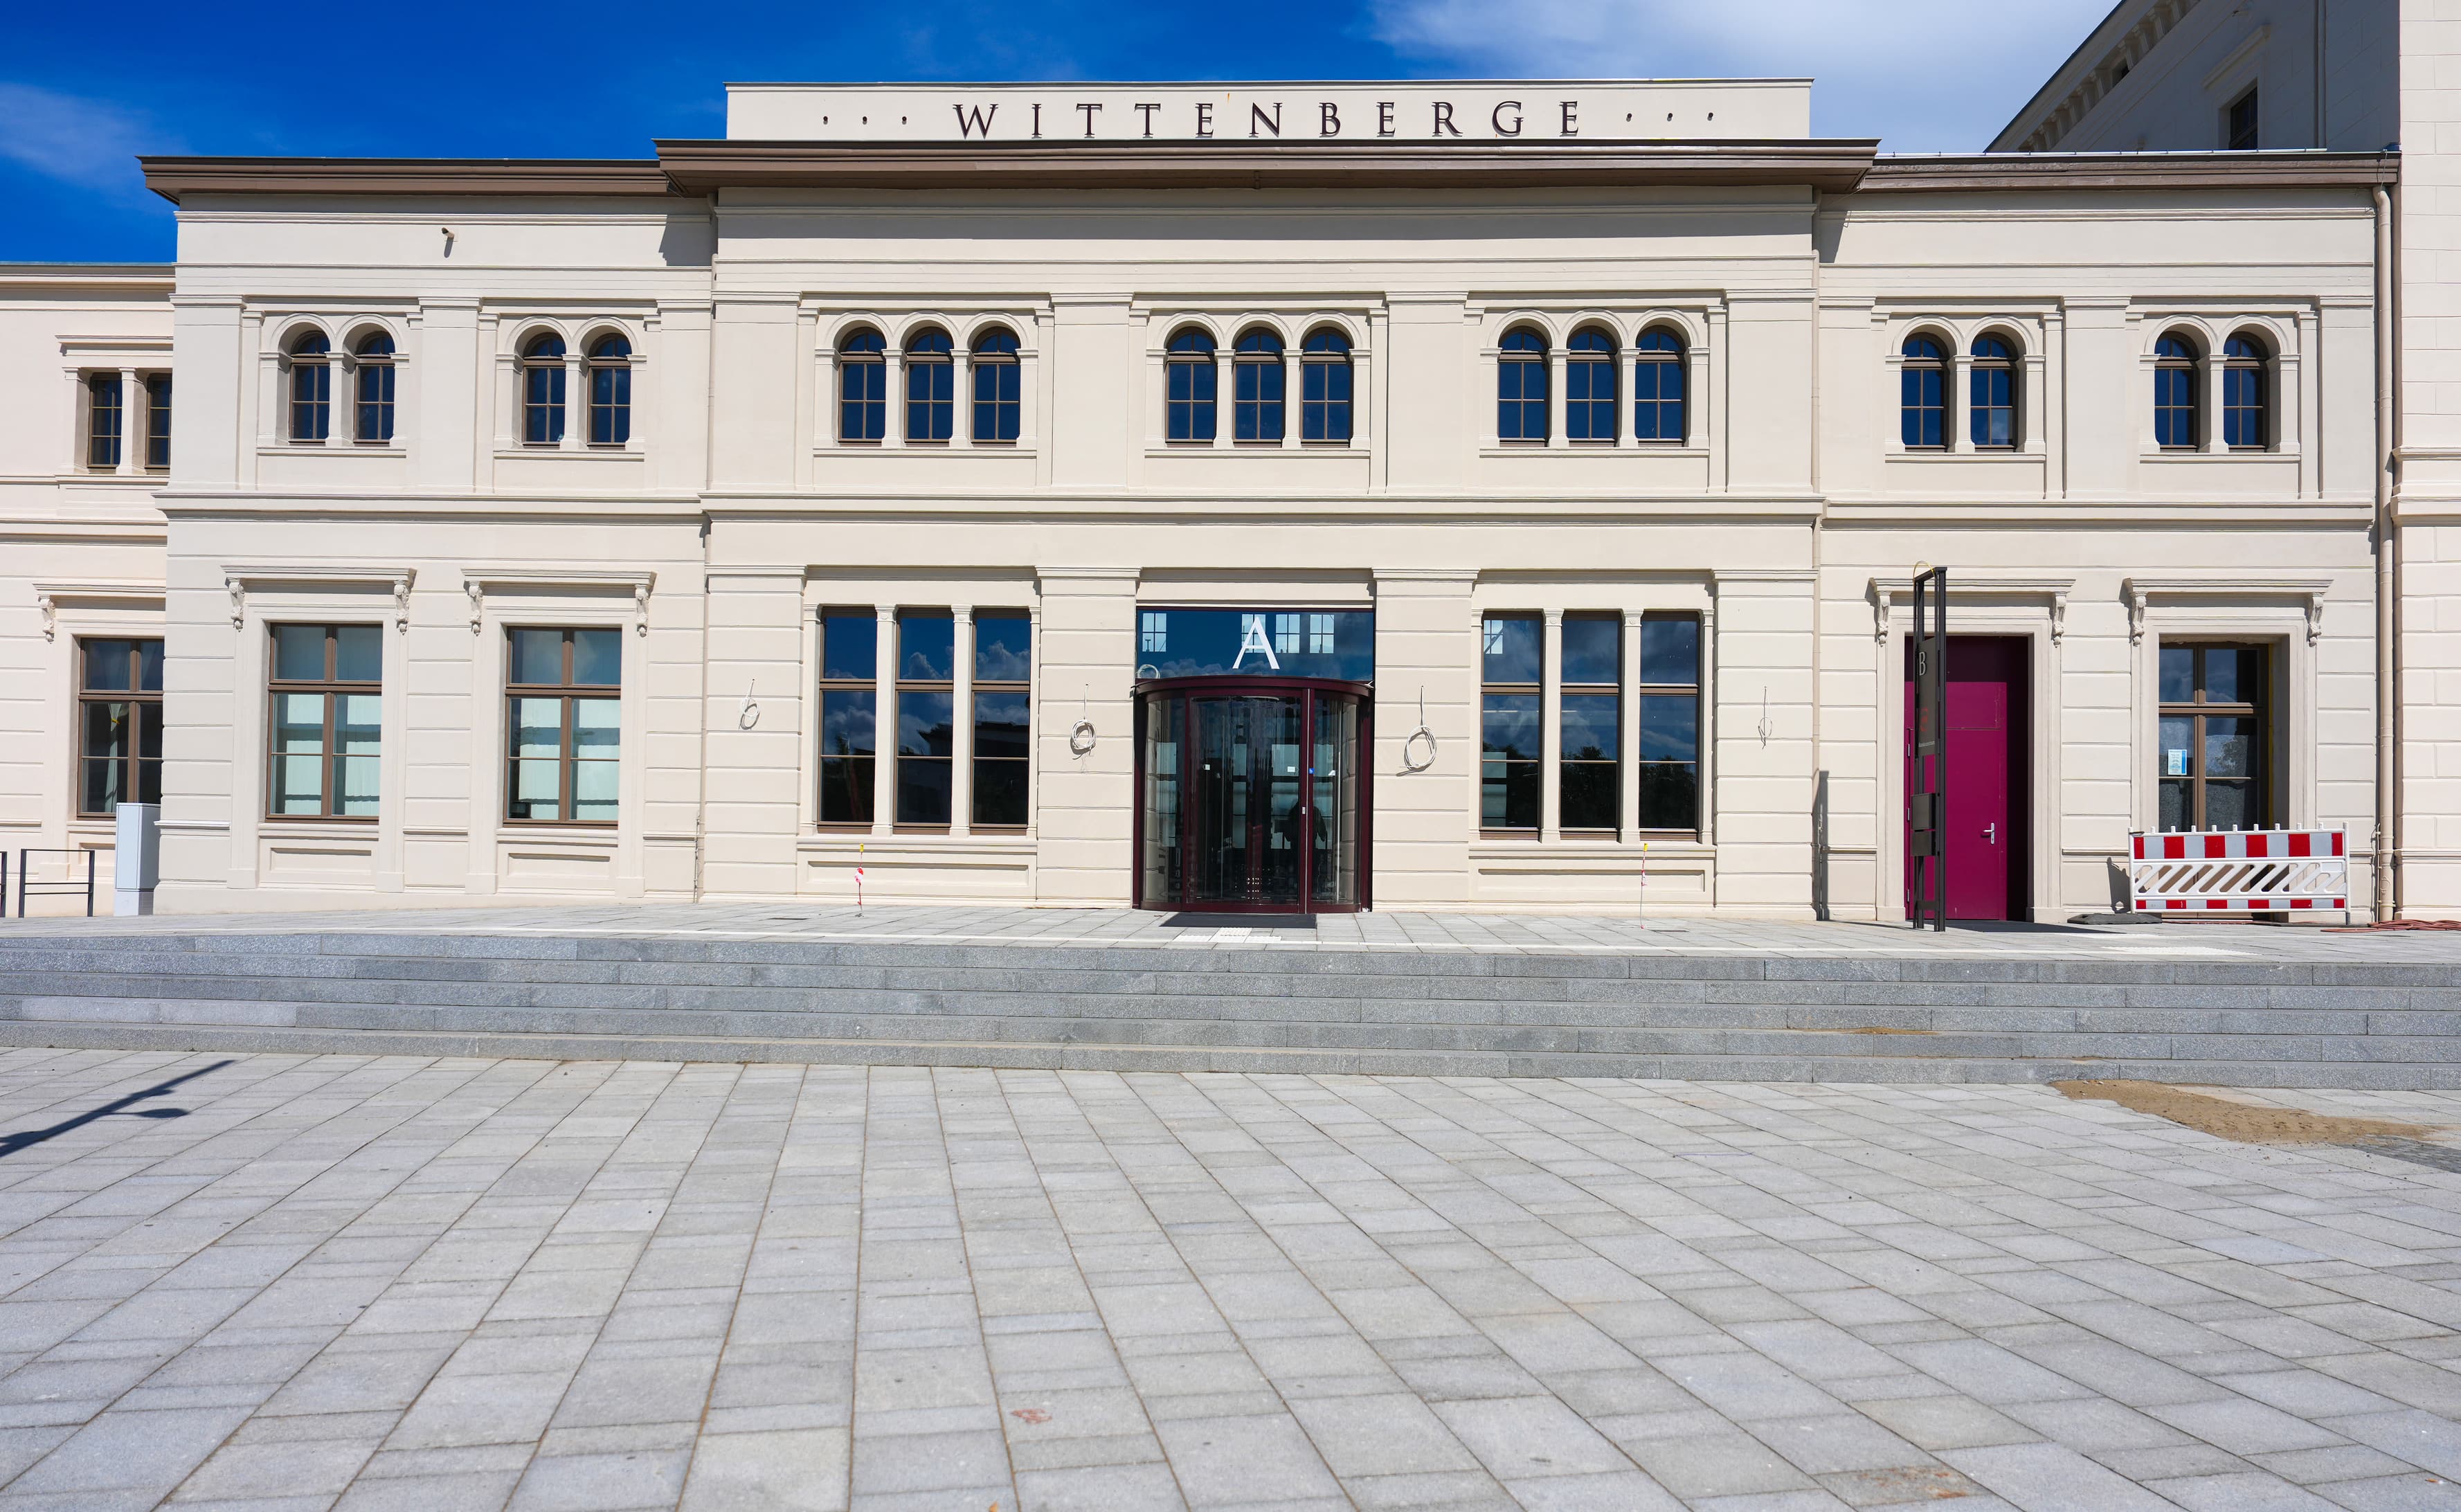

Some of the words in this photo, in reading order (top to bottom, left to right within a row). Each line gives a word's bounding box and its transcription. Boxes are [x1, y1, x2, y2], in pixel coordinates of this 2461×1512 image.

[953, 100, 1579, 138] WITTENBERGE
[1232, 616, 1280, 669] A
[1918, 651, 1927, 676] B
